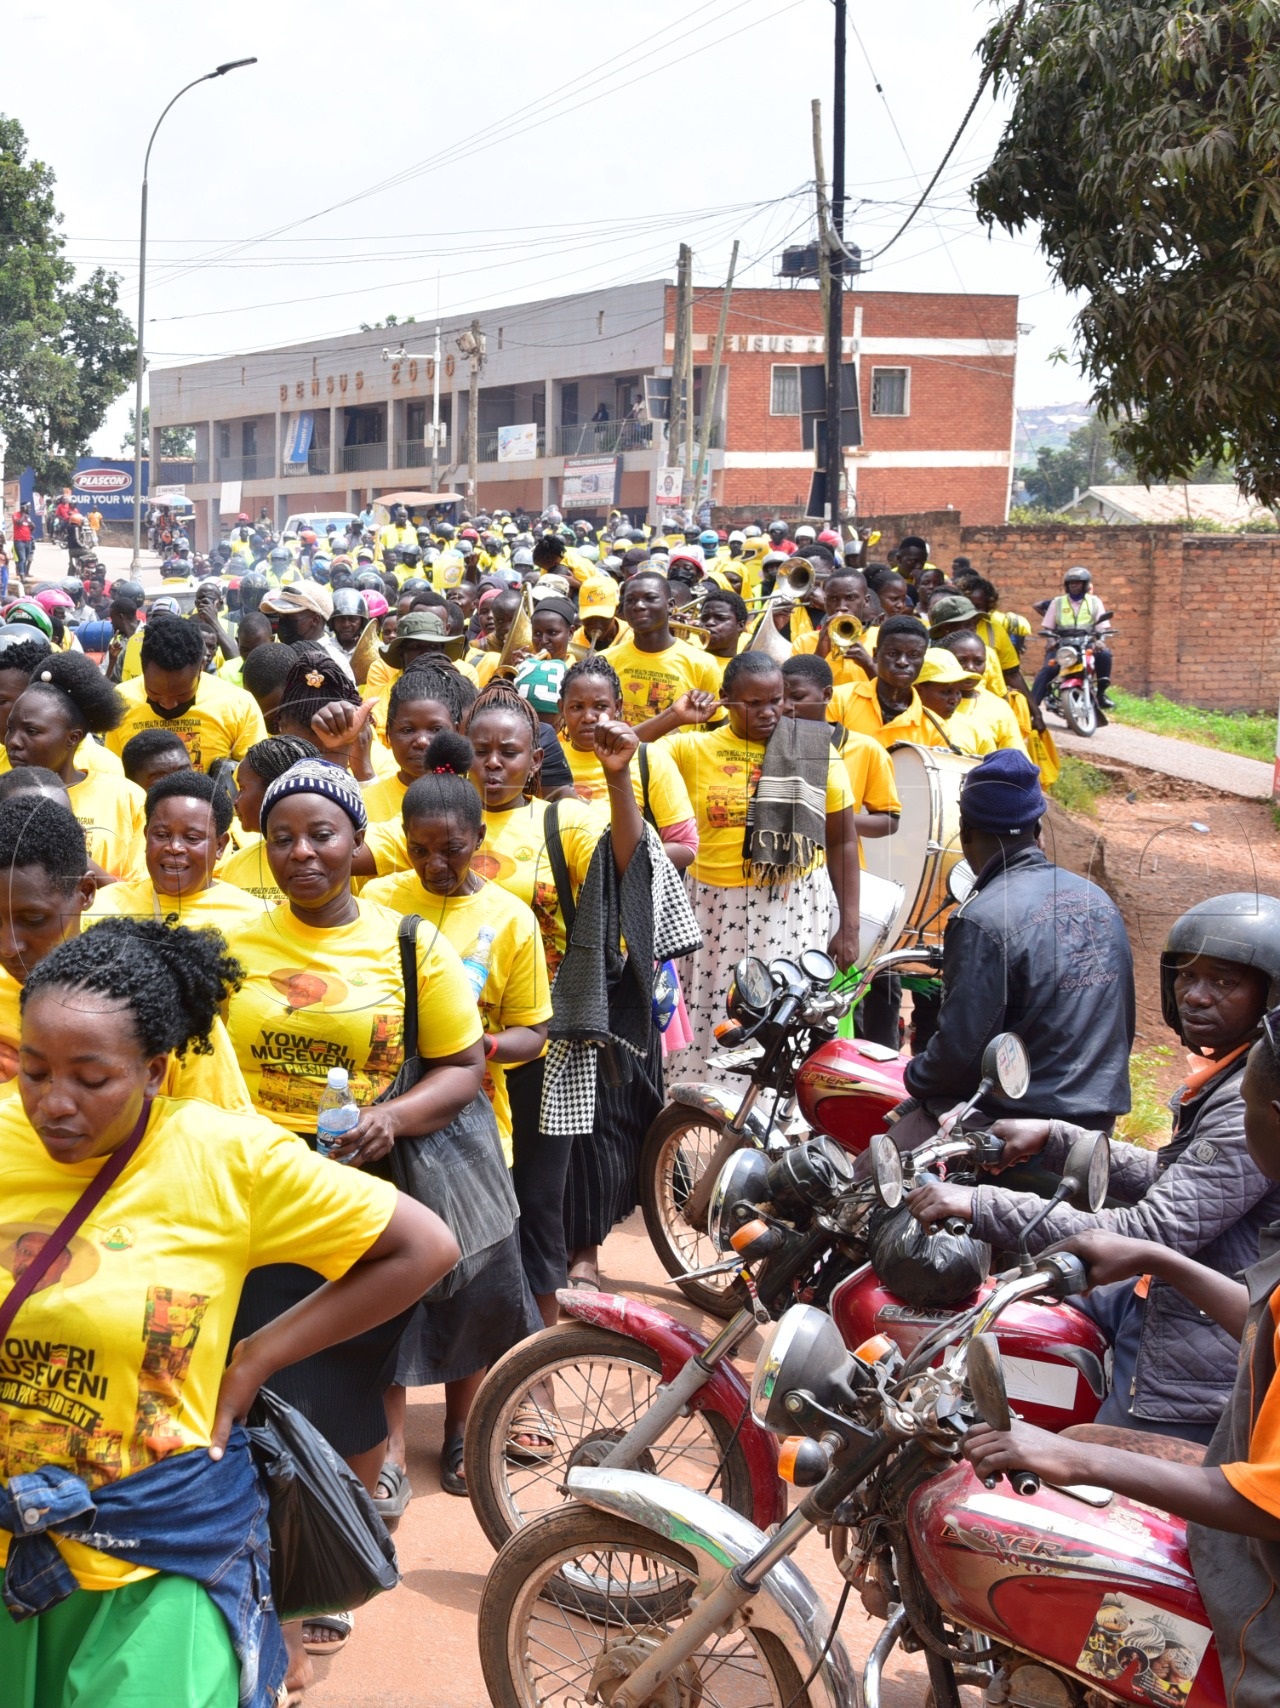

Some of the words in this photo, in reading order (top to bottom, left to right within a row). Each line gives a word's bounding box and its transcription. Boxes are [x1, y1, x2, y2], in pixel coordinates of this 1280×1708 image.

[707, 335, 796, 353] BENSUS
[808, 335, 860, 353] 20
[279, 370, 365, 401] BENSUS
[391, 354, 456, 385] 2000
[78, 476, 126, 486] PLASCON
[91, 495, 120, 504] YOUR
[159, 719, 180, 727] CREATION
[180, 718, 201, 727] PROGRAM
[260, 1029, 349, 1058] YOWERI
[250, 1043, 358, 1071] MUSEVENI
[285, 1063, 330, 1077] PRESID
[800, 1071, 847, 1086] BOXER
[877, 1303, 958, 1320] BOXE
[0, 1337, 96, 1373] OWERI
[16, 1385, 96, 1428] PRESIDENT
